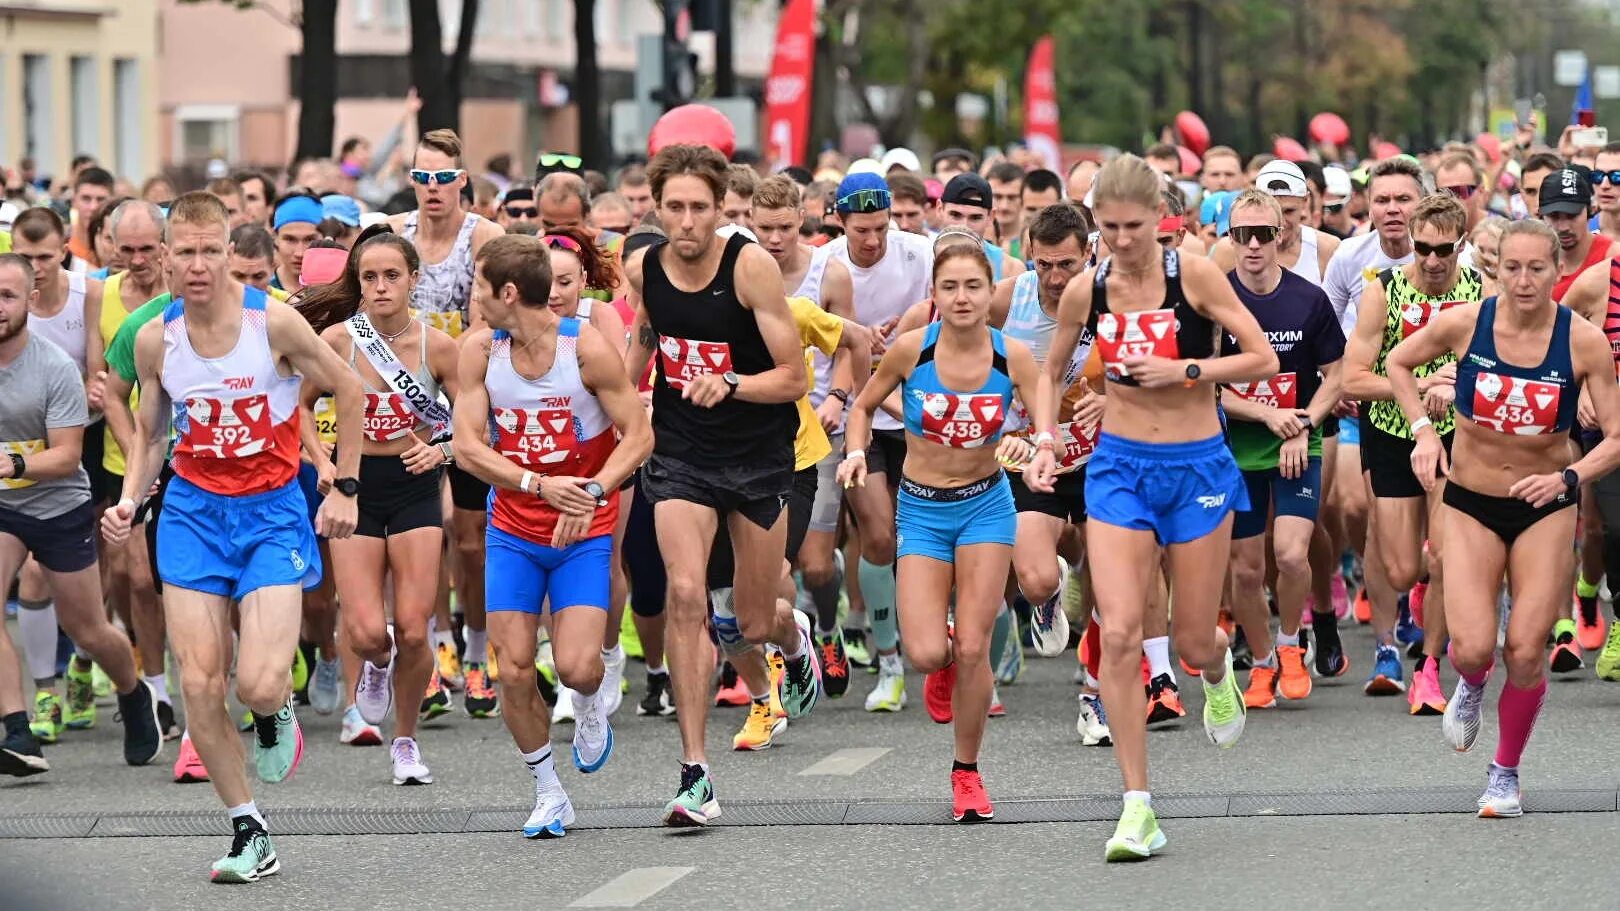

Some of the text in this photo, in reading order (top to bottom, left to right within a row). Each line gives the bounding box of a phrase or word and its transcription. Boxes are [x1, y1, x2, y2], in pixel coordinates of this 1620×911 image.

[1117, 342, 1155, 359] 437
[1494, 405, 1535, 424] 436
[211, 425, 252, 445] 392
[942, 421, 982, 438] 438
[518, 435, 556, 452] 434
[1064, 442, 1094, 456] 11-1
